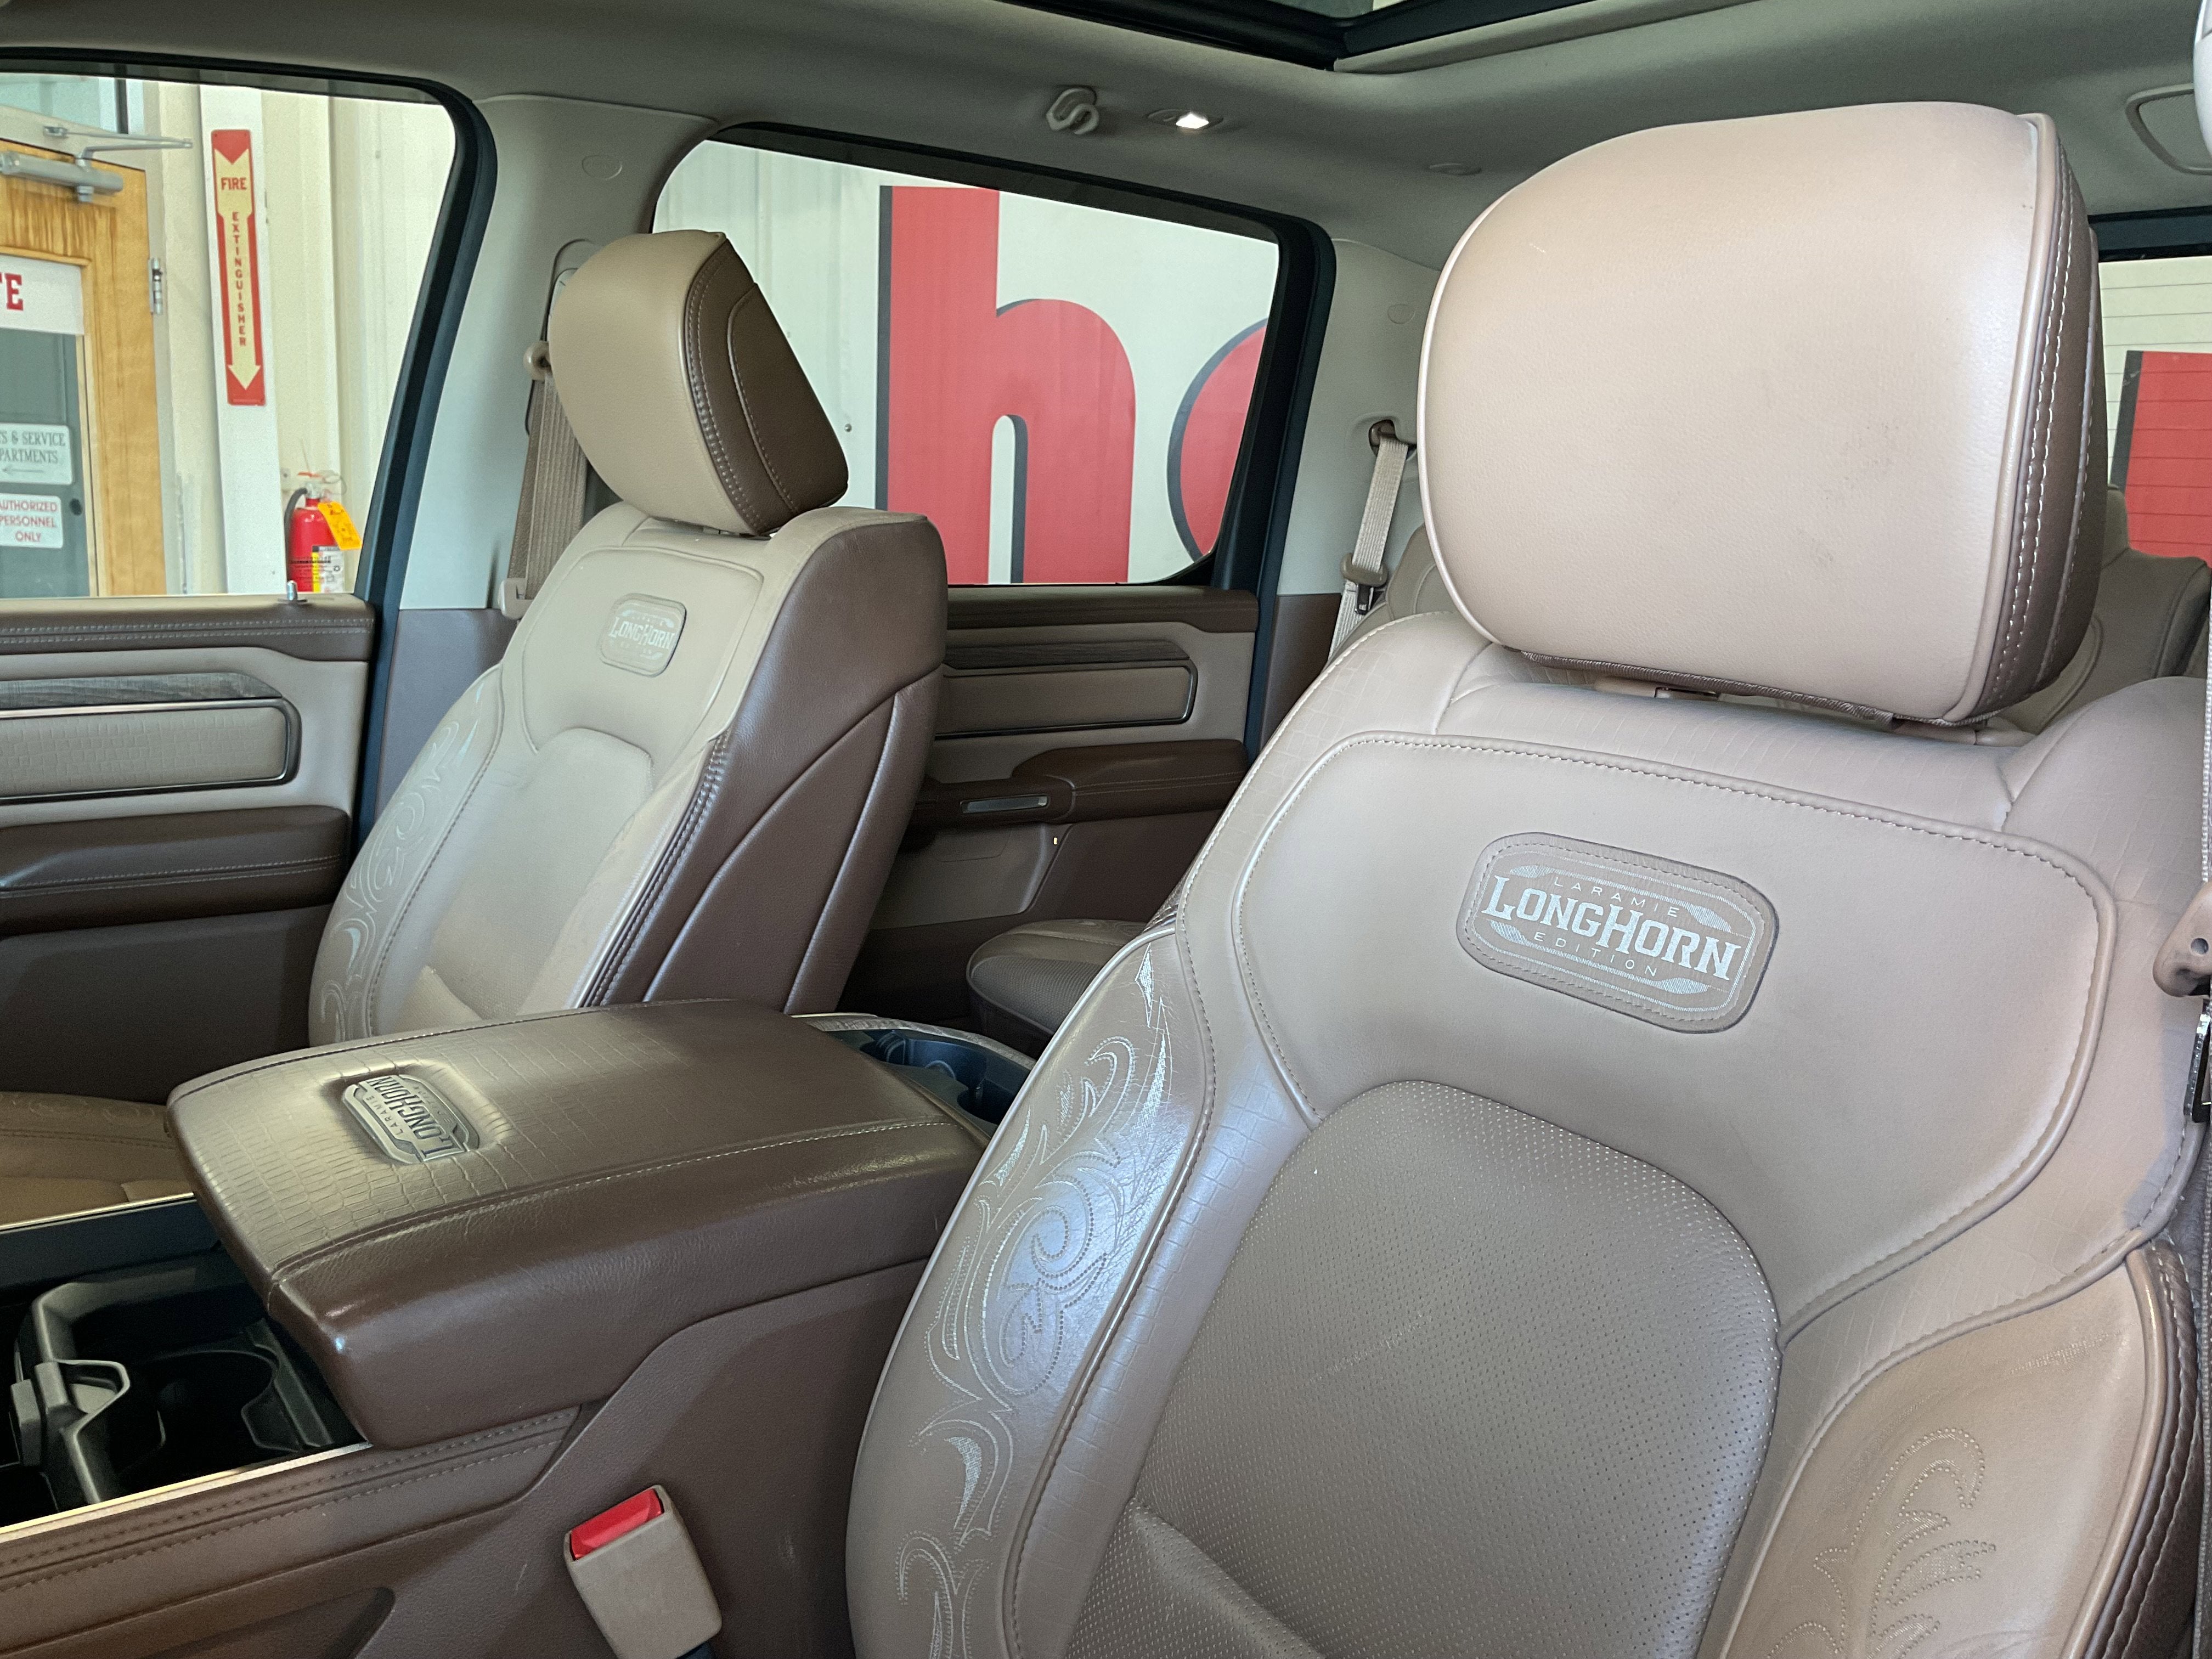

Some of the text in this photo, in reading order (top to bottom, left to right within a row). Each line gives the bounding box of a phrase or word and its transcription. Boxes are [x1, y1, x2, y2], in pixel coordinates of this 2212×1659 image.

[221, 177, 247, 190] FIRE
[0, 272, 24, 311] E
[232, 211, 247, 346] EXTINGUISHER
[0, 430, 8, 444] S
[22, 431, 65, 447] SERVICE
[0, 500, 58, 512] UTHORIZED
[15, 530, 42, 543] ONLY
[608, 616, 675, 649] LONGHORN
[1553, 876, 1680, 918] LARAMIE
[1481, 874, 1742, 981] LONGHORN
[1533, 932, 1657, 977] EDITION
[366, 1095, 404, 1136] LARAMIE
[366, 1076, 455, 1158] LONGHORN
